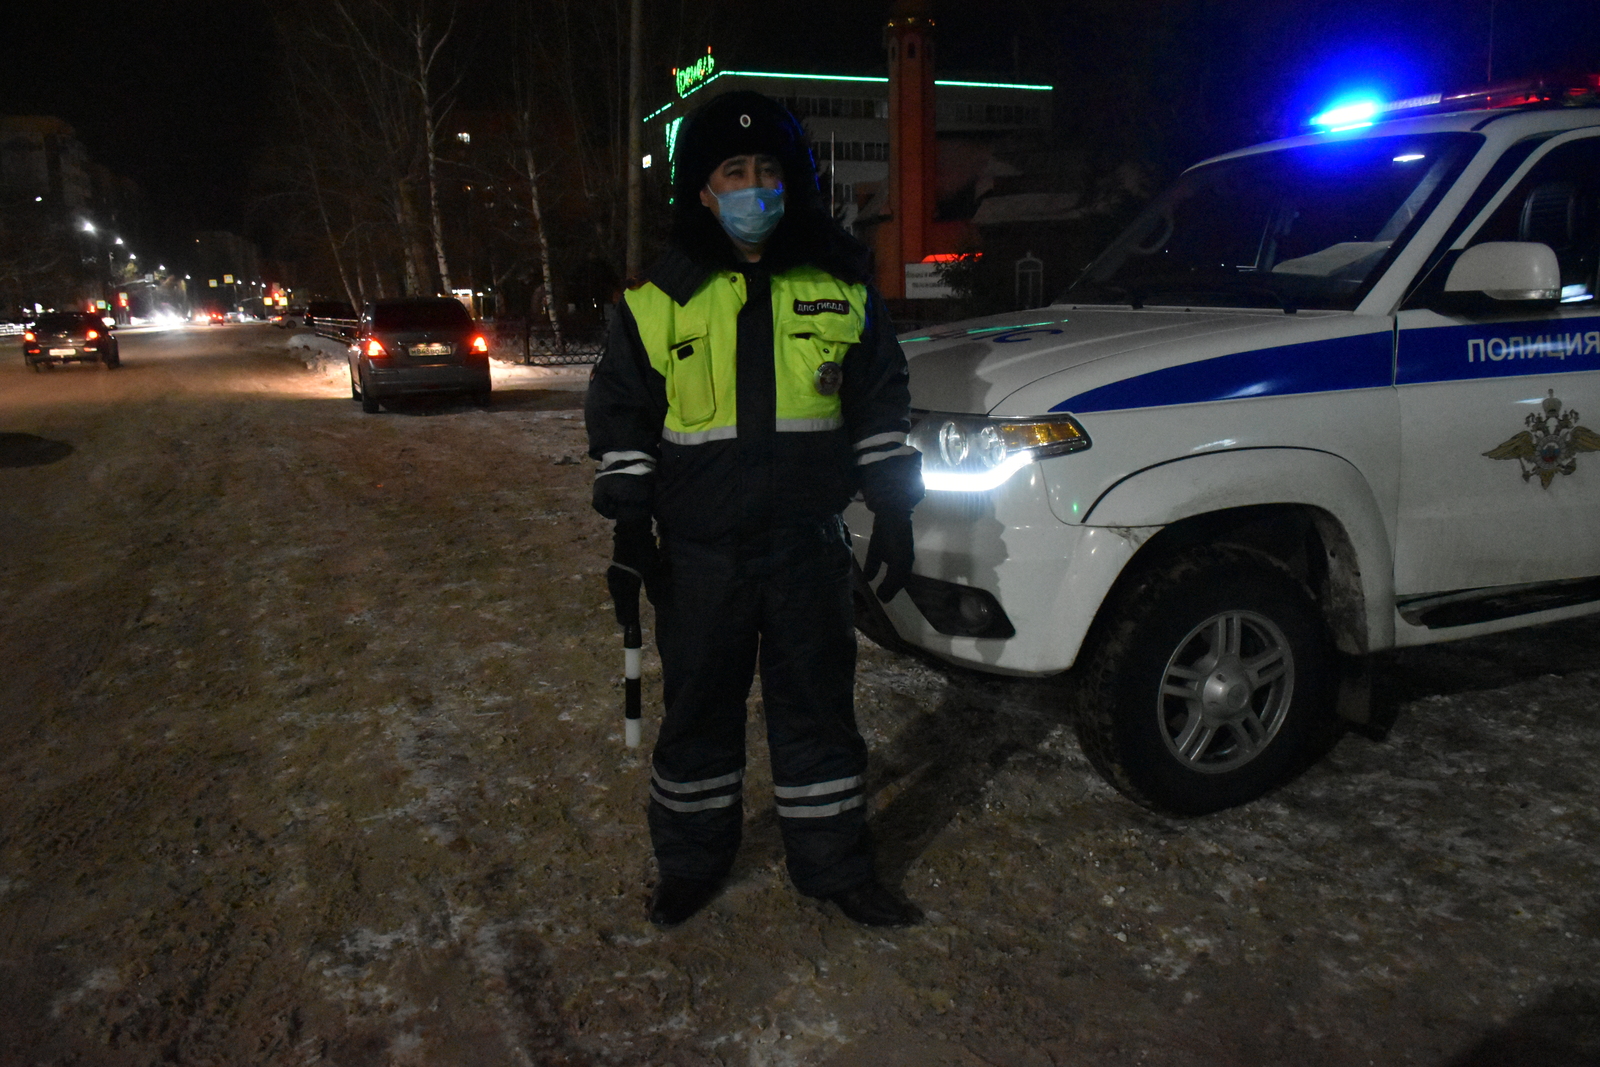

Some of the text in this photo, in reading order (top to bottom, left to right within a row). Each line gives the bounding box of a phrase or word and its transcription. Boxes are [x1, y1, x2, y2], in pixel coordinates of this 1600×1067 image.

[797, 301, 845, 312] ДПС ГИБДД
[1467, 331, 1600, 362] ПОЛИЦИЯ
